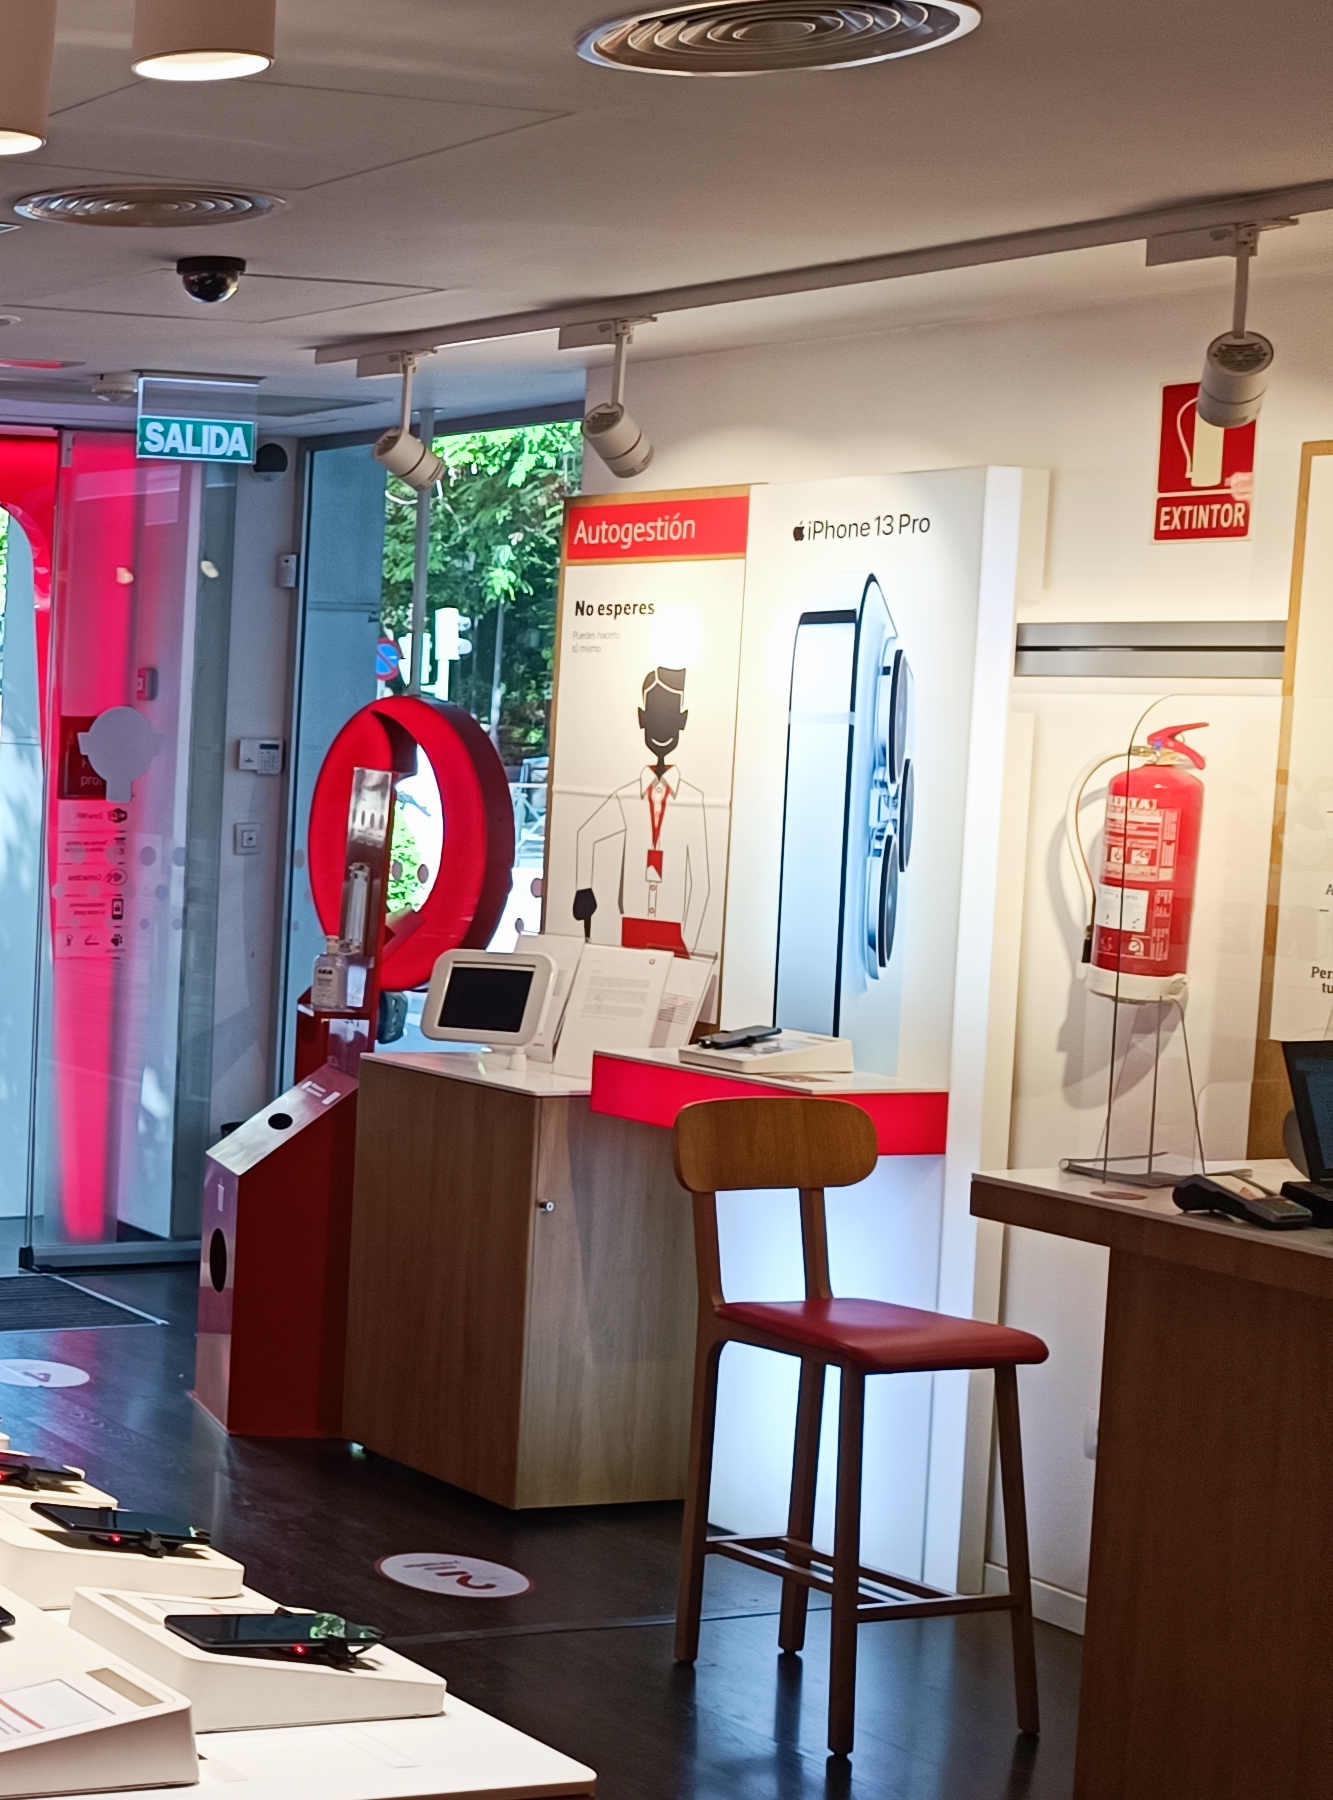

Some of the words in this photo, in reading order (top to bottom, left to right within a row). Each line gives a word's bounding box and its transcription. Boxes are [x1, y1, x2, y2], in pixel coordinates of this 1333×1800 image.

[144, 422, 249, 457] SALIDA
[573, 512, 696, 549] Autogestión
[808, 519, 871, 541] iPhone
[874, 515, 894, 536] 13
[898, 513, 931, 534] Pro
[1159, 503, 1246, 531] EXTINTOR
[575, 600, 594, 616] No
[598, 603, 655, 619] esperes
